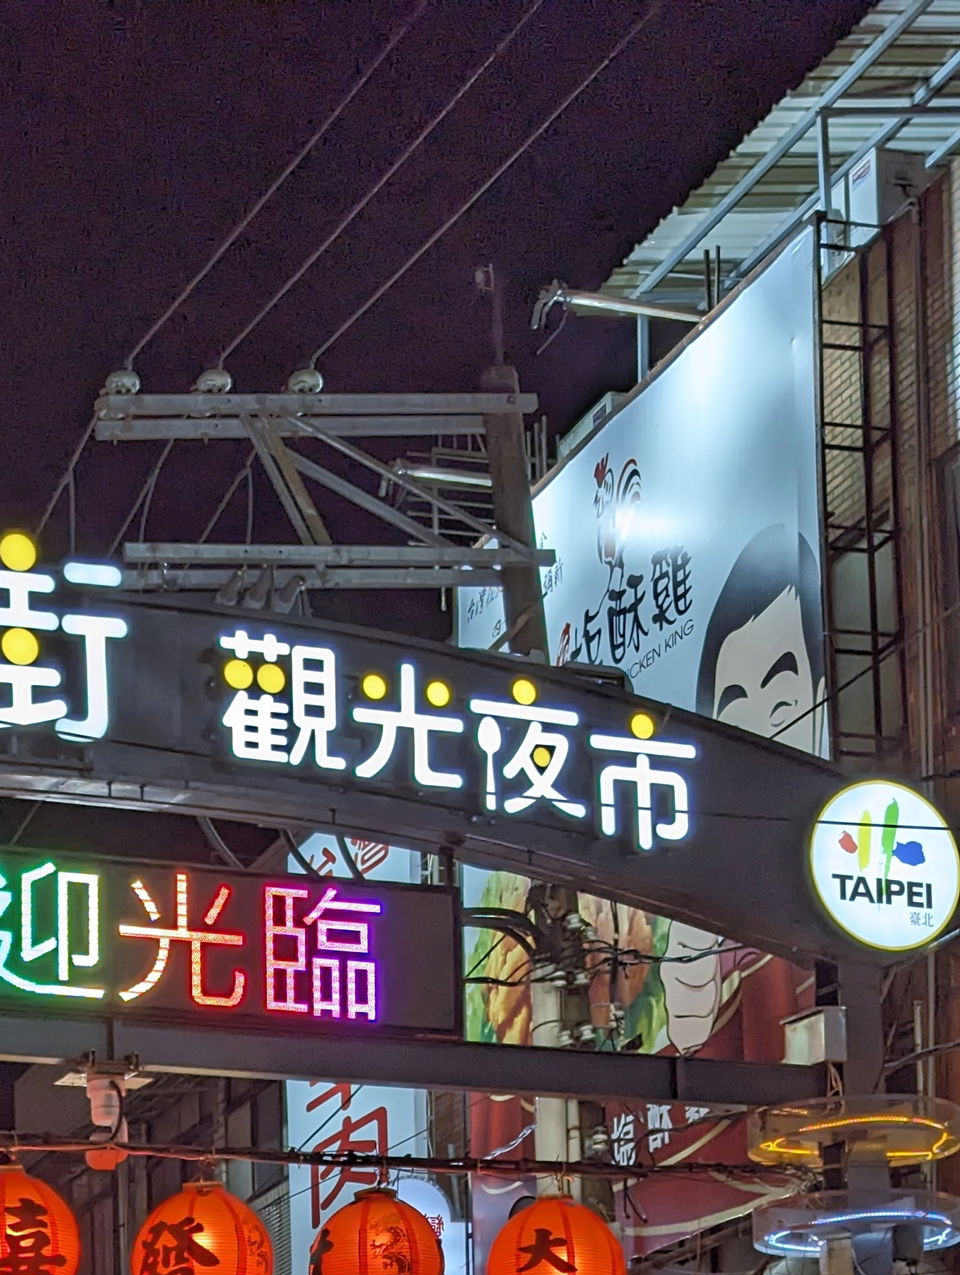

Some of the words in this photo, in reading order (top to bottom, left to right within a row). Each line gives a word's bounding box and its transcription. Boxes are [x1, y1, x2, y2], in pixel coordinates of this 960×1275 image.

[664, 618, 695, 653] KING
[220, 629, 697, 850] 觀光夜市
[832, 873, 933, 909] TAIPEI
